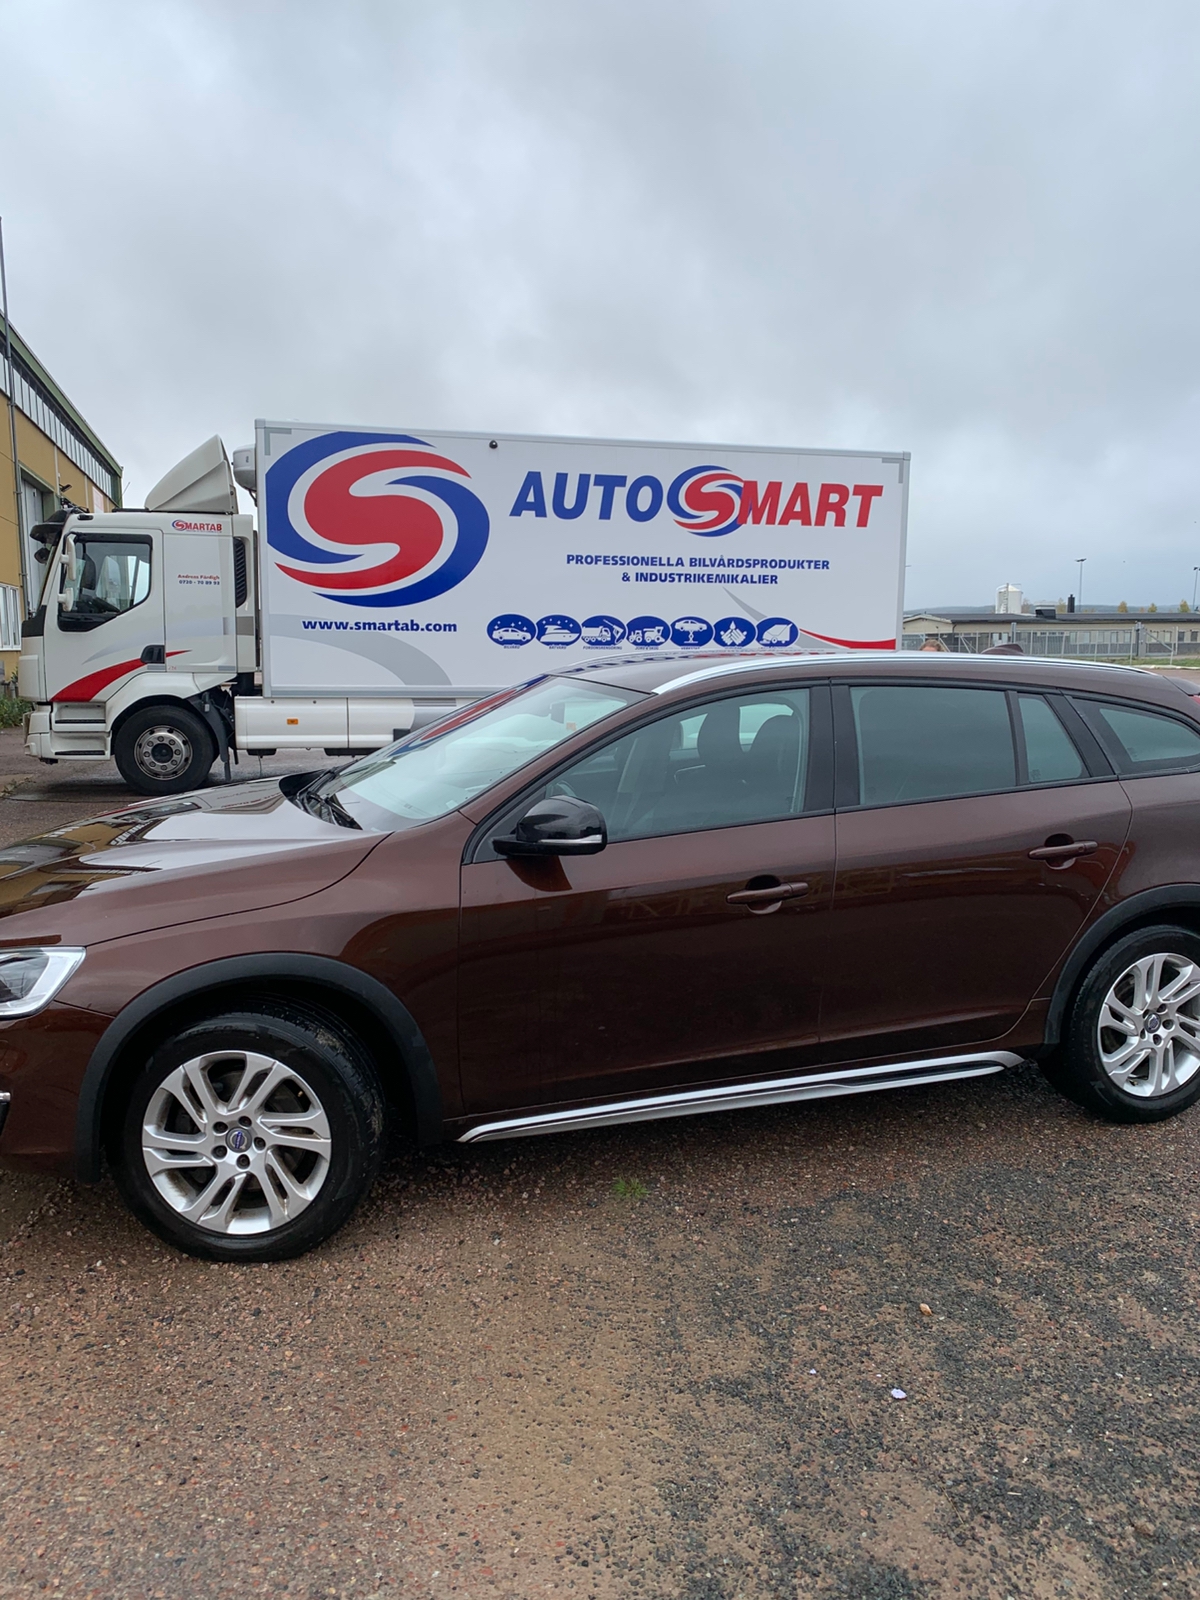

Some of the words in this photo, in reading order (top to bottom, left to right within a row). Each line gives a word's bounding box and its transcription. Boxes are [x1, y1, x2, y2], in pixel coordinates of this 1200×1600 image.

[509, 465, 883, 538] AUTOSMART
[172, 519, 222, 531] SMARTAB
[566, 554, 685, 568] PROFESSIONELLA
[689, 555, 830, 570] BILVÅRDSPRODUKTER
[621, 571, 631, 582] &
[635, 572, 778, 585] INDUSTRIKEMIKALIER
[302, 618, 457, 632] www.smartab.com
